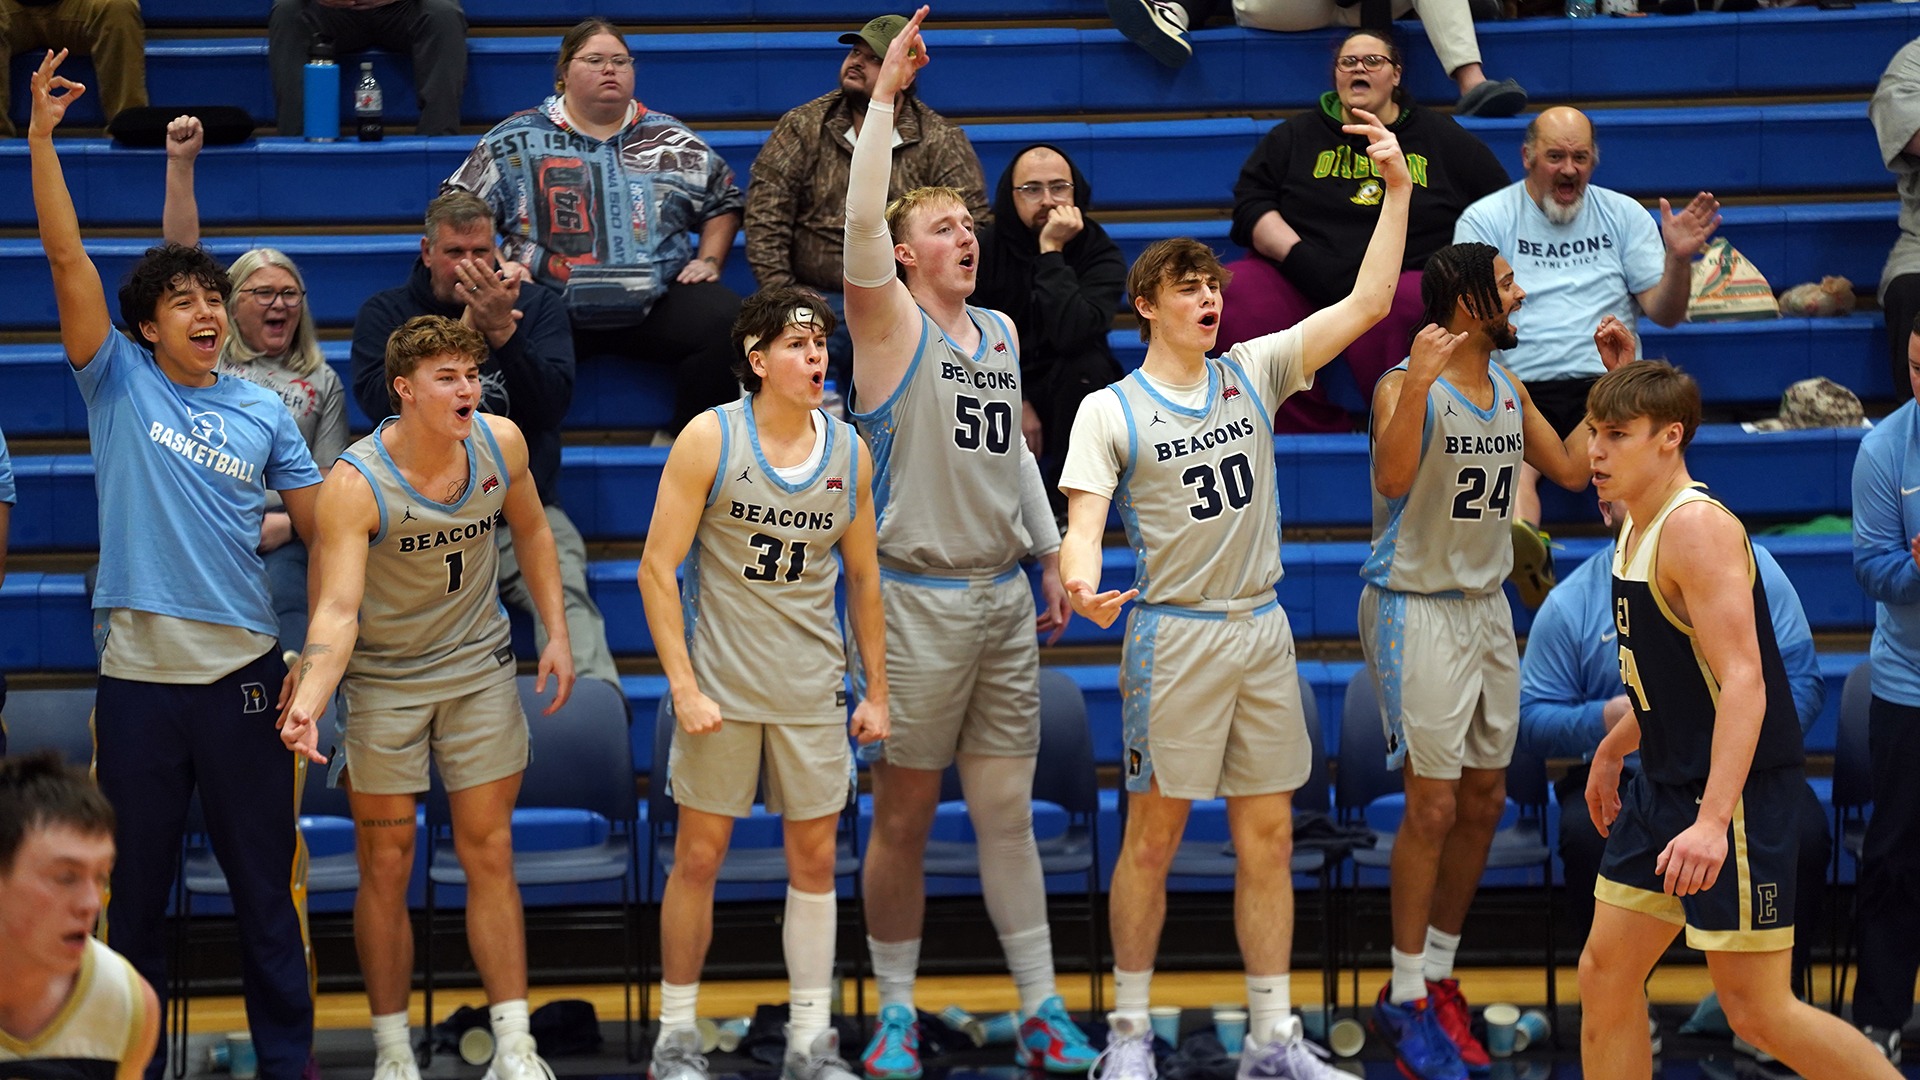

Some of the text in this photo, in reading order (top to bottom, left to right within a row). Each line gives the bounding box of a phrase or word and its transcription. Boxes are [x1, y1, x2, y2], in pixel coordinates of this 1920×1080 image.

[490, 131, 535, 159] EST.
[1313, 145, 1427, 187] OREN
[1518, 234, 1613, 258] BEACONS
[953, 392, 1013, 456] 50
[1154, 416, 1254, 463] BEACONS
[1444, 432, 1522, 455] BEACONS
[150, 421, 255, 483] BASKETBALL
[1180, 450, 1254, 523] 30
[1450, 463, 1514, 521] 24
[399, 508, 503, 552] BEACONS
[729, 500, 834, 530] BEACONS
[443, 549, 465, 595] 1
[742, 532, 811, 583] 31
[1757, 883, 1777, 924] E
